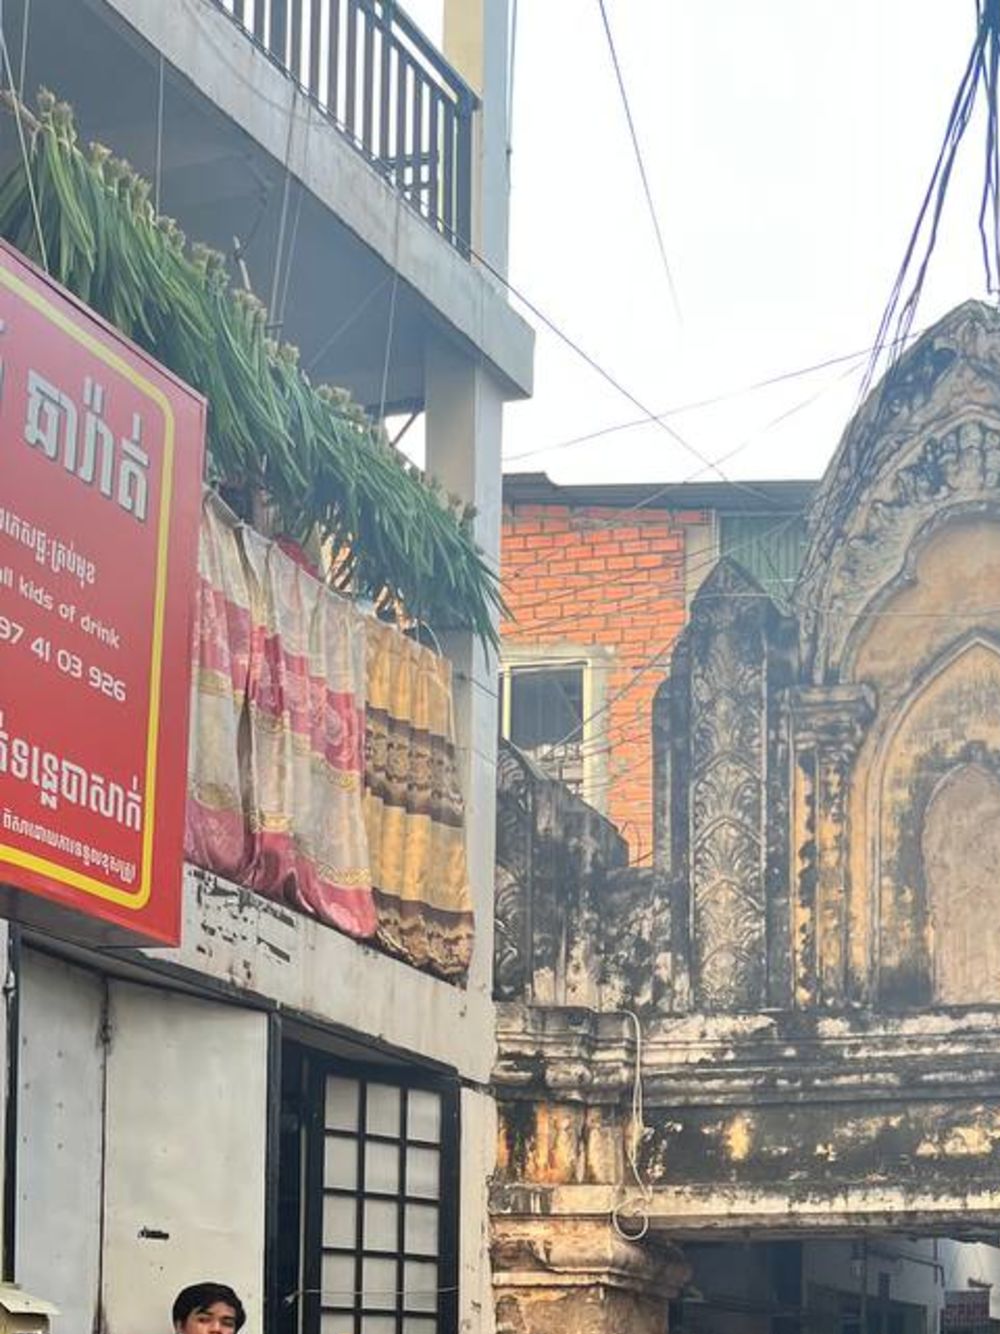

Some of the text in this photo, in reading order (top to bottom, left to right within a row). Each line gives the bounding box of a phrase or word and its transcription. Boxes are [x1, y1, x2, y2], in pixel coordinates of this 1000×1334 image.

[0, 566, 121, 649] ll kids of drink
[31, 636, 50, 662] 41
[57, 648, 83, 678] 03
[89, 666, 127, 701] 926
